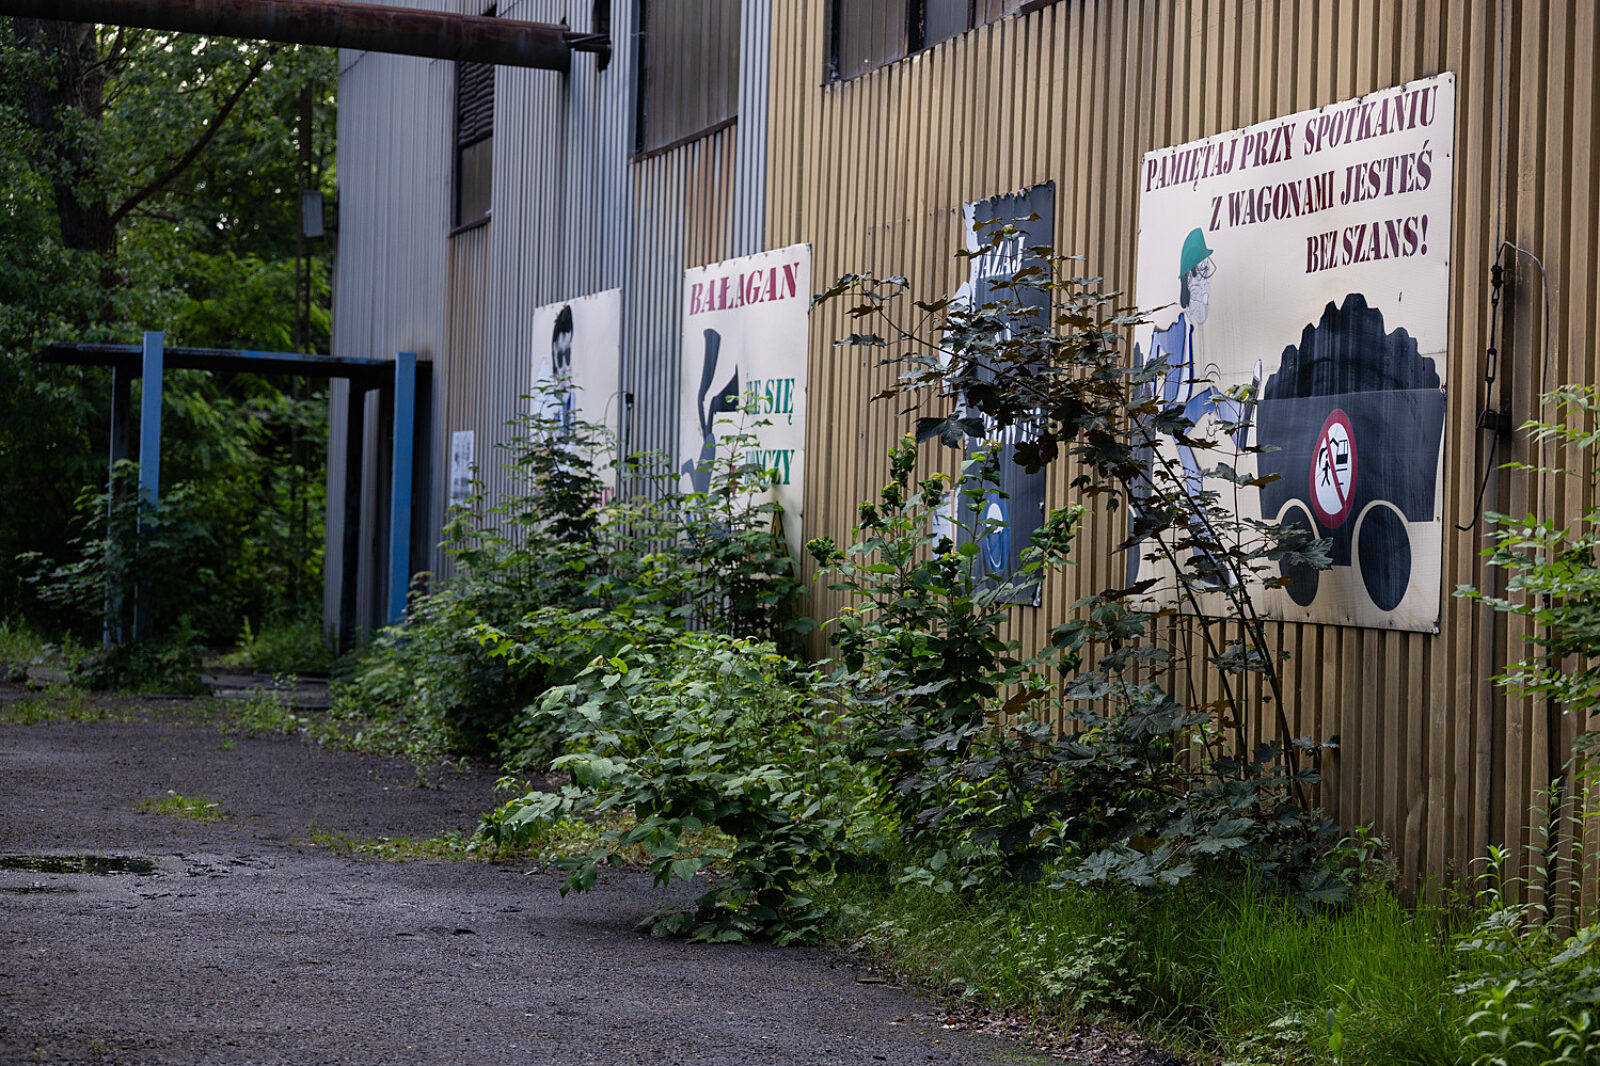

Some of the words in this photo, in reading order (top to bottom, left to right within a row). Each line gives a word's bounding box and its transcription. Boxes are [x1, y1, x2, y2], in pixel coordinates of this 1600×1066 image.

[1145, 138, 1238, 192] PAMIĘTAJ
[1239, 122, 1297, 171] PRZY
[1303, 85, 1439, 156] SPOTKANIU
[1208, 195, 1223, 232] Z
[1228, 170, 1335, 228] WAGONAMI
[1340, 139, 1433, 206] JESTEŚ
[1305, 230, 1339, 274] BEZ
[1342, 214, 1429, 267] SZANS!
[689, 262, 800, 316] BAŁAGAN
[763, 377, 796, 427] SIĘ
